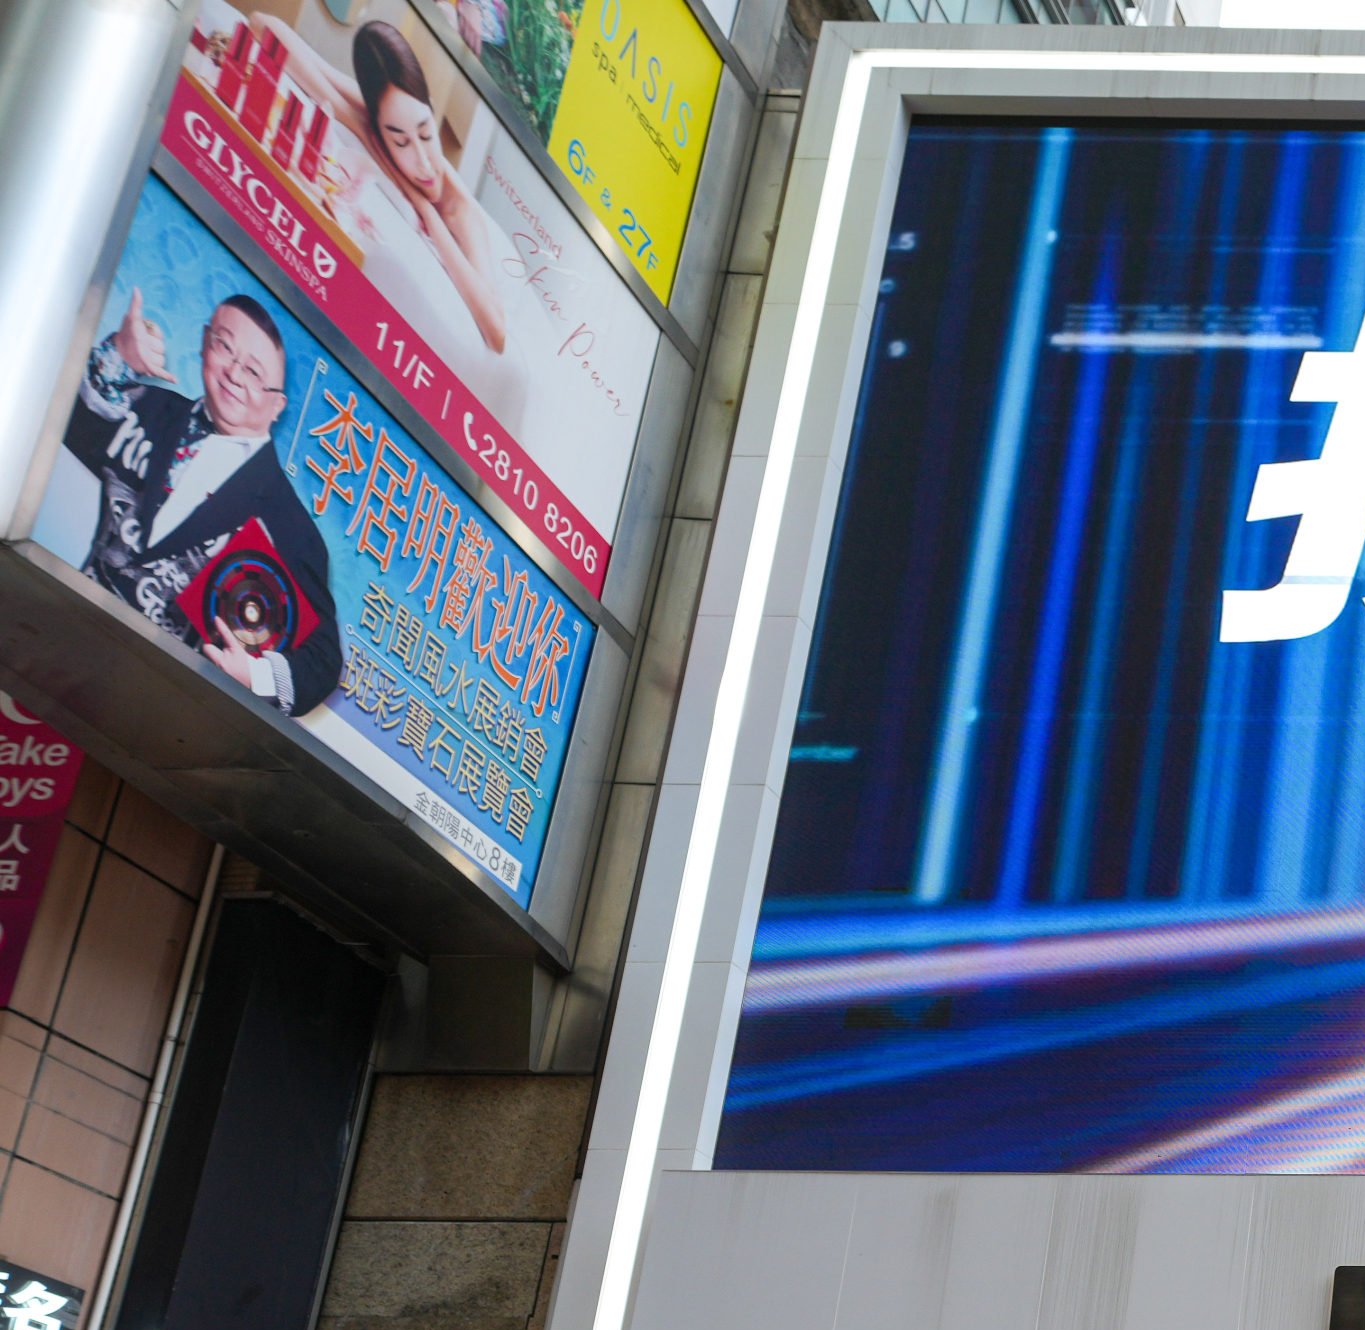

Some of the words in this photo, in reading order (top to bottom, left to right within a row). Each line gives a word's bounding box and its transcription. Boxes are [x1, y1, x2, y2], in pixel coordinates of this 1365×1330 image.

[592, 42, 617, 84] spa
[626, 94, 682, 175] medical
[183, 110, 307, 257] GLYCEL
[486, 155, 562, 261] Switzerland
[568, 139, 596, 186] 6F
[618, 208, 659, 270] 27F
[375, 321, 435, 390] 11/F
[480, 434, 539, 510] 2810
[543, 502, 599, 575] 8206
[306, 388, 570, 719] 李居明歡迎你
[0, 736, 70, 767] ake
[339, 644, 535, 844] 斑彩寶石展覽會
[358, 580, 549, 783] 奇聞風水展銷會
[414, 789, 519, 888] 金朝陽中心8樓
